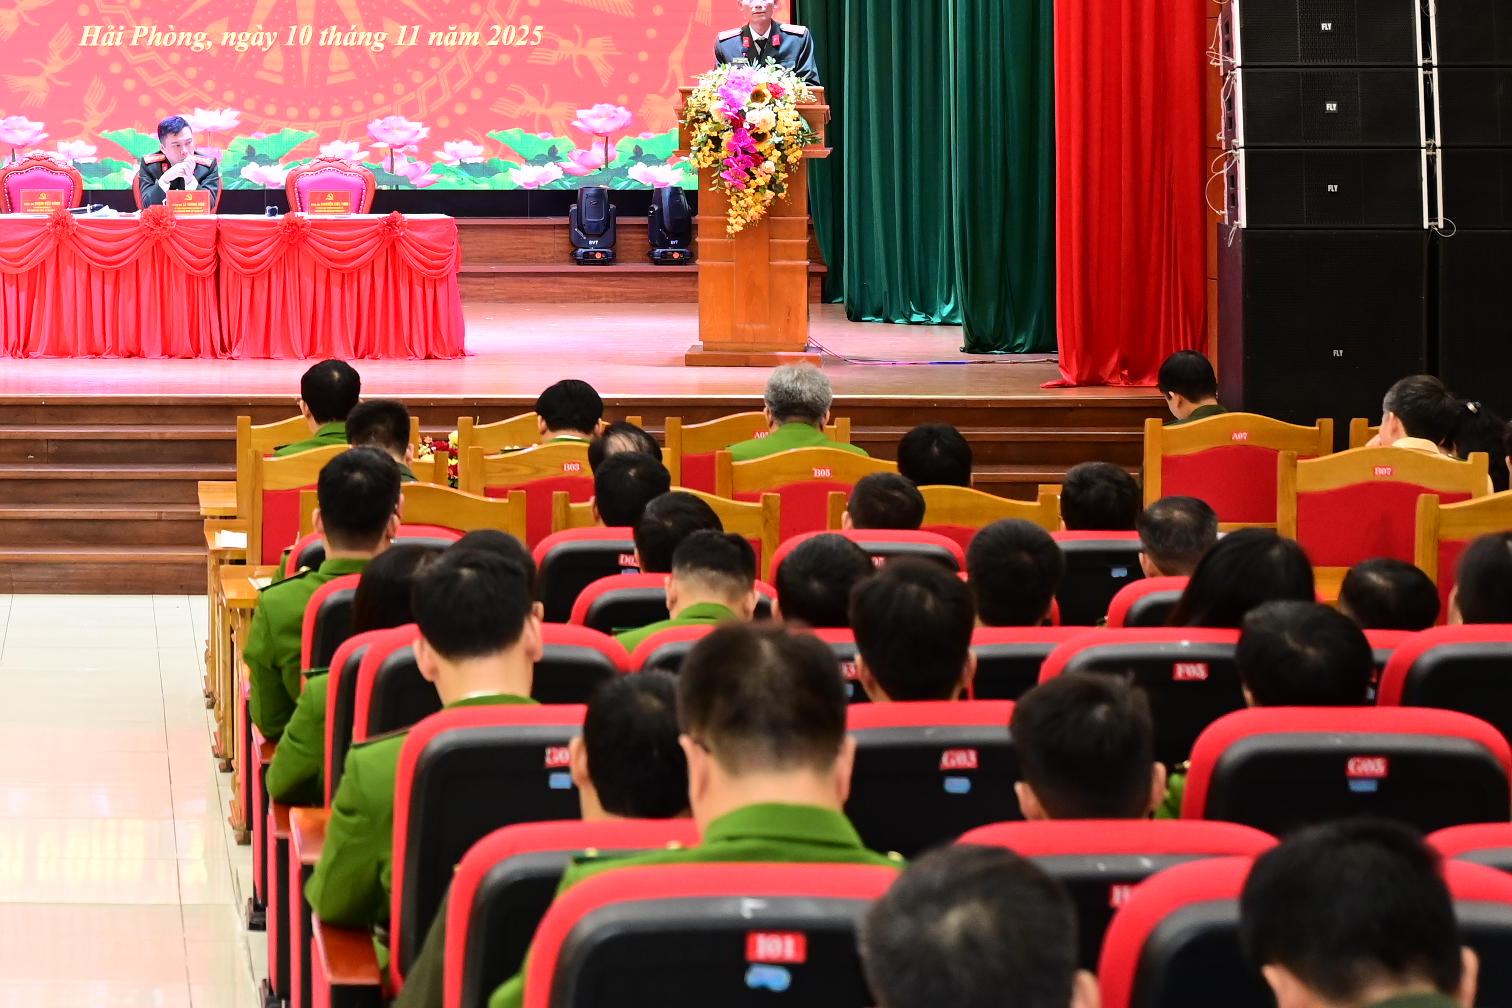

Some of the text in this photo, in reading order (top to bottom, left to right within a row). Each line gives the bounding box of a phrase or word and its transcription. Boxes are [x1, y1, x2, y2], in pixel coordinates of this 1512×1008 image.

[79, 24, 543, 51] Hải Phòng, ngày 10 tháng 11 năm 2025
[1232, 432, 1247, 440] A07
[814, 469, 830, 477] B05
